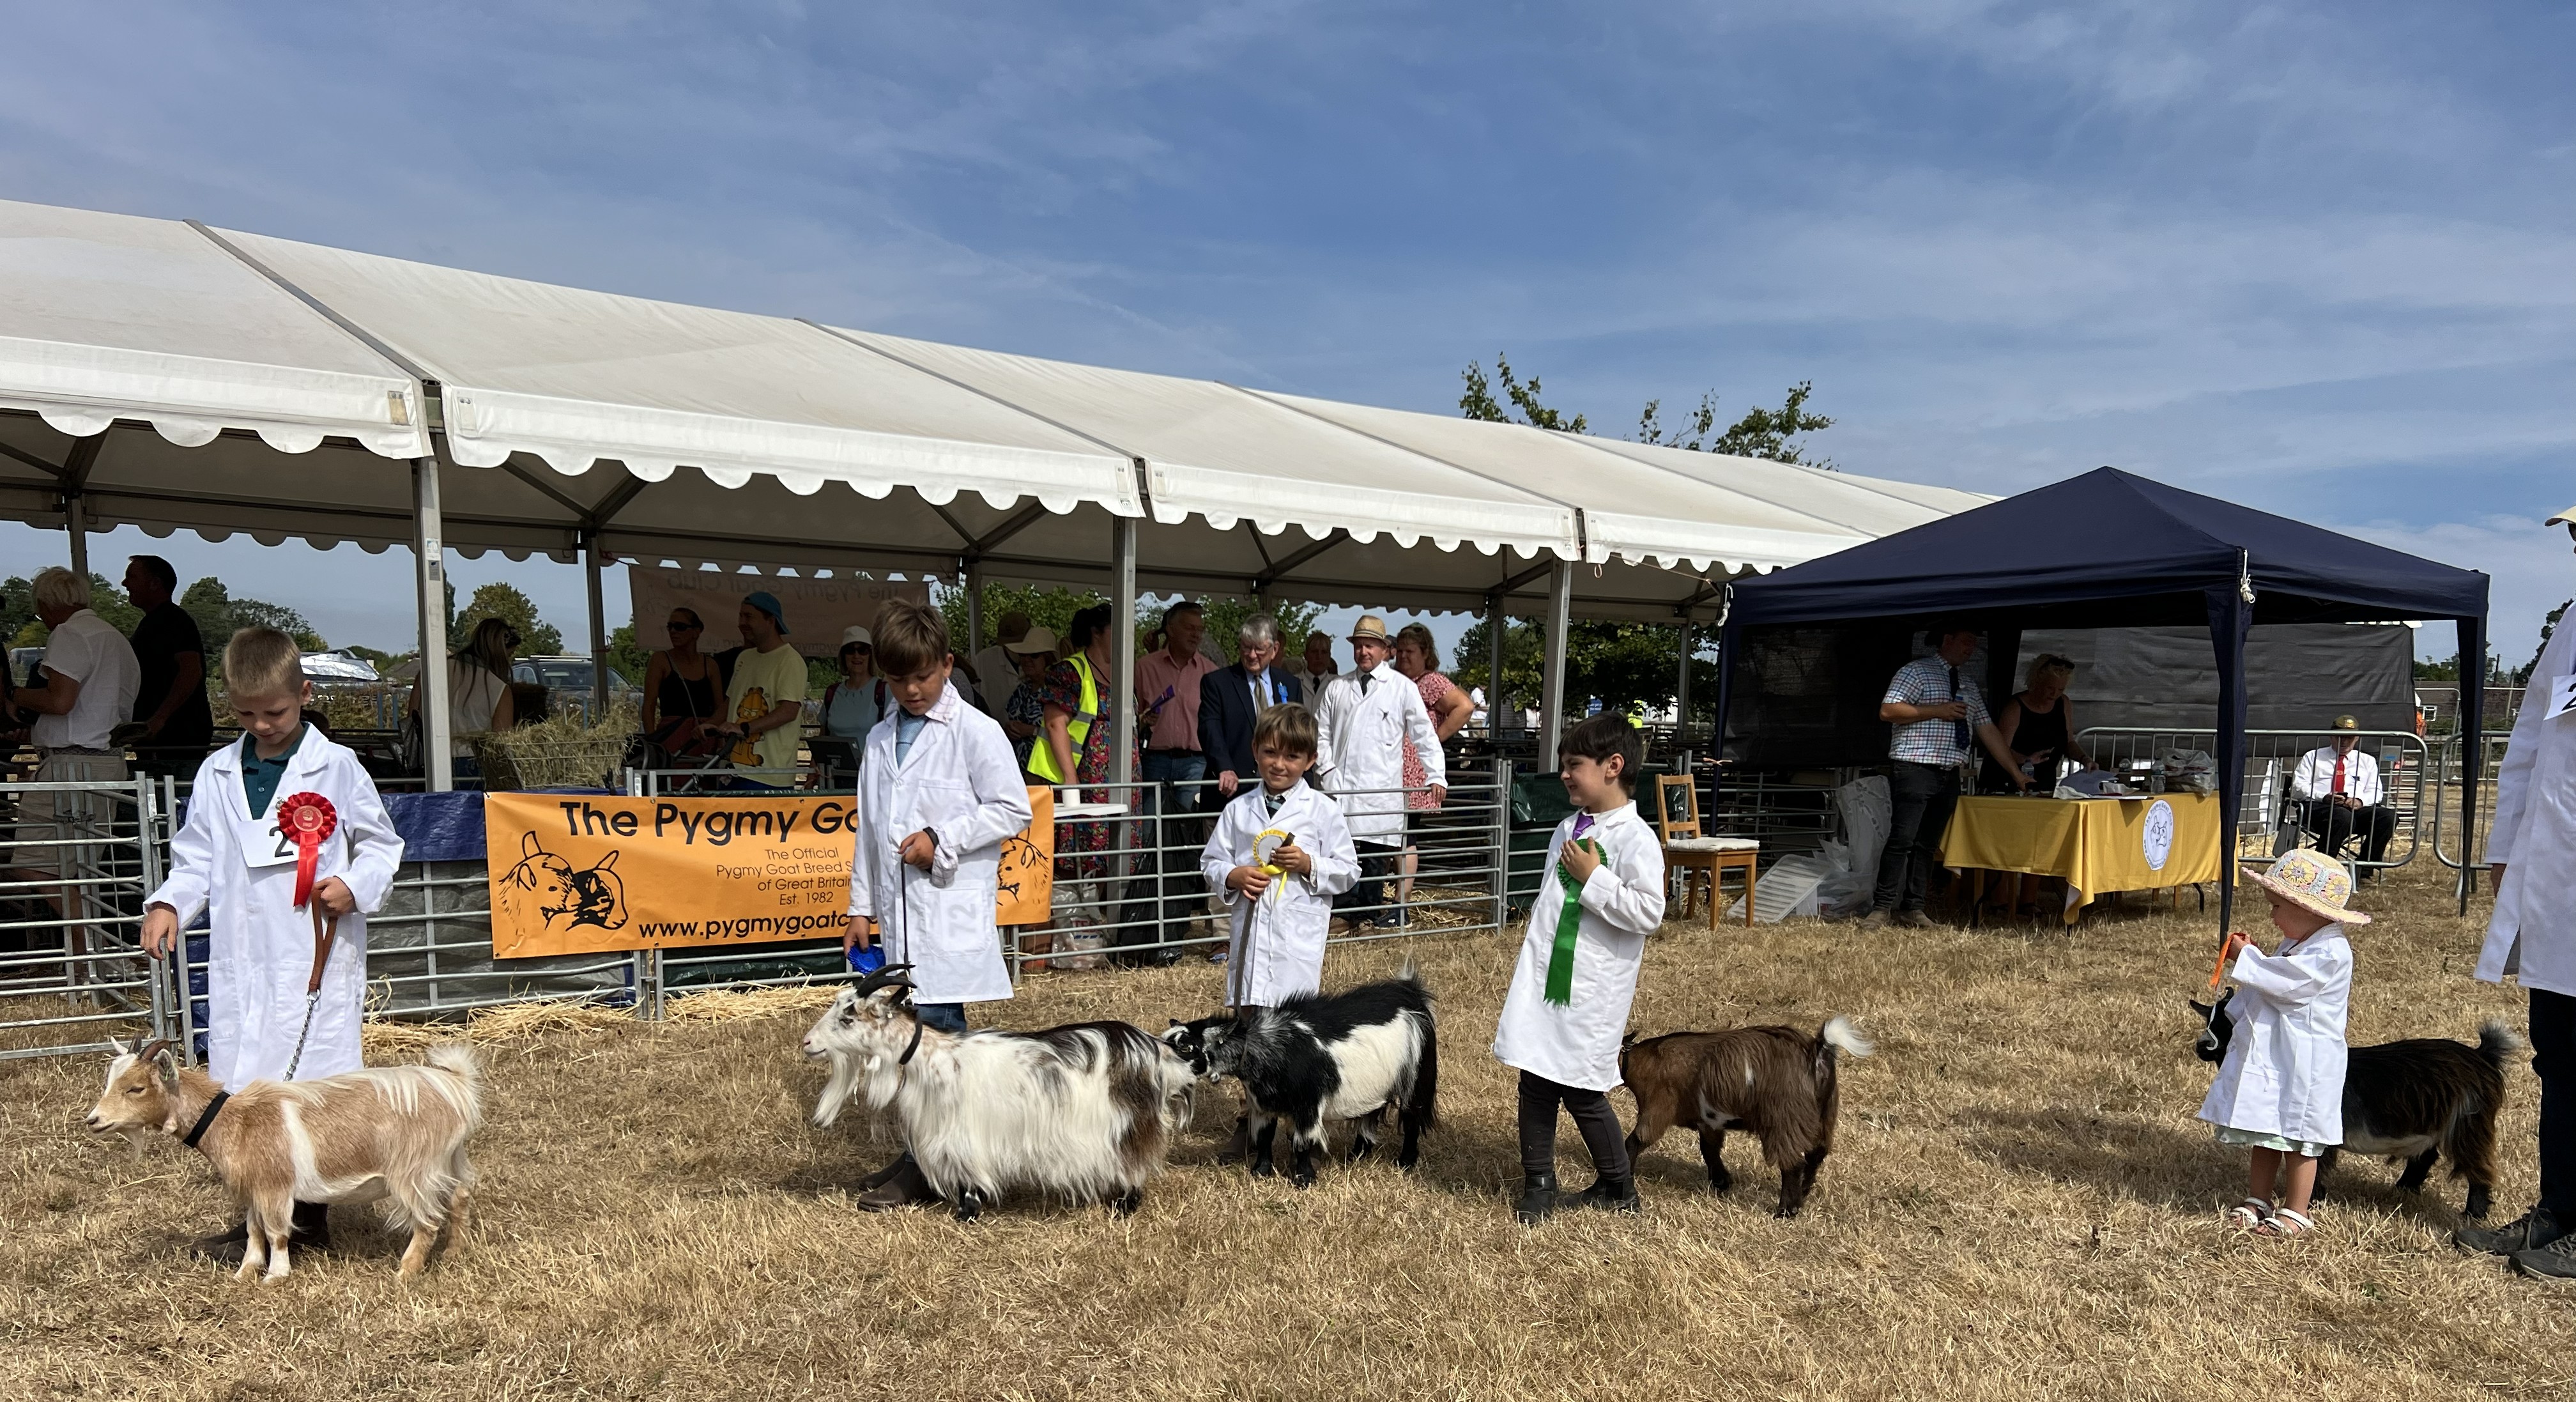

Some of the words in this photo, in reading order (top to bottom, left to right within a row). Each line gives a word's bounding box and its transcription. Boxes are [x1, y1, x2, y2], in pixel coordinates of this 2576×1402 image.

[560, 801, 638, 836] The
[656, 803, 800, 846] Pygmy
[269, 826, 294, 858] 2
[765, 849, 788, 860] The
[793, 847, 839, 859] Official
[716, 865, 762, 879] Pygmy
[767, 863, 800, 875] Goat
[804, 861, 843, 874] Breed
[758, 879, 771, 891] of
[775, 878, 814, 890] Great
[780, 893, 799, 905] Est.
[806, 891, 834, 904] 1982
[639, 910, 850, 939] www.pygmygoatc
